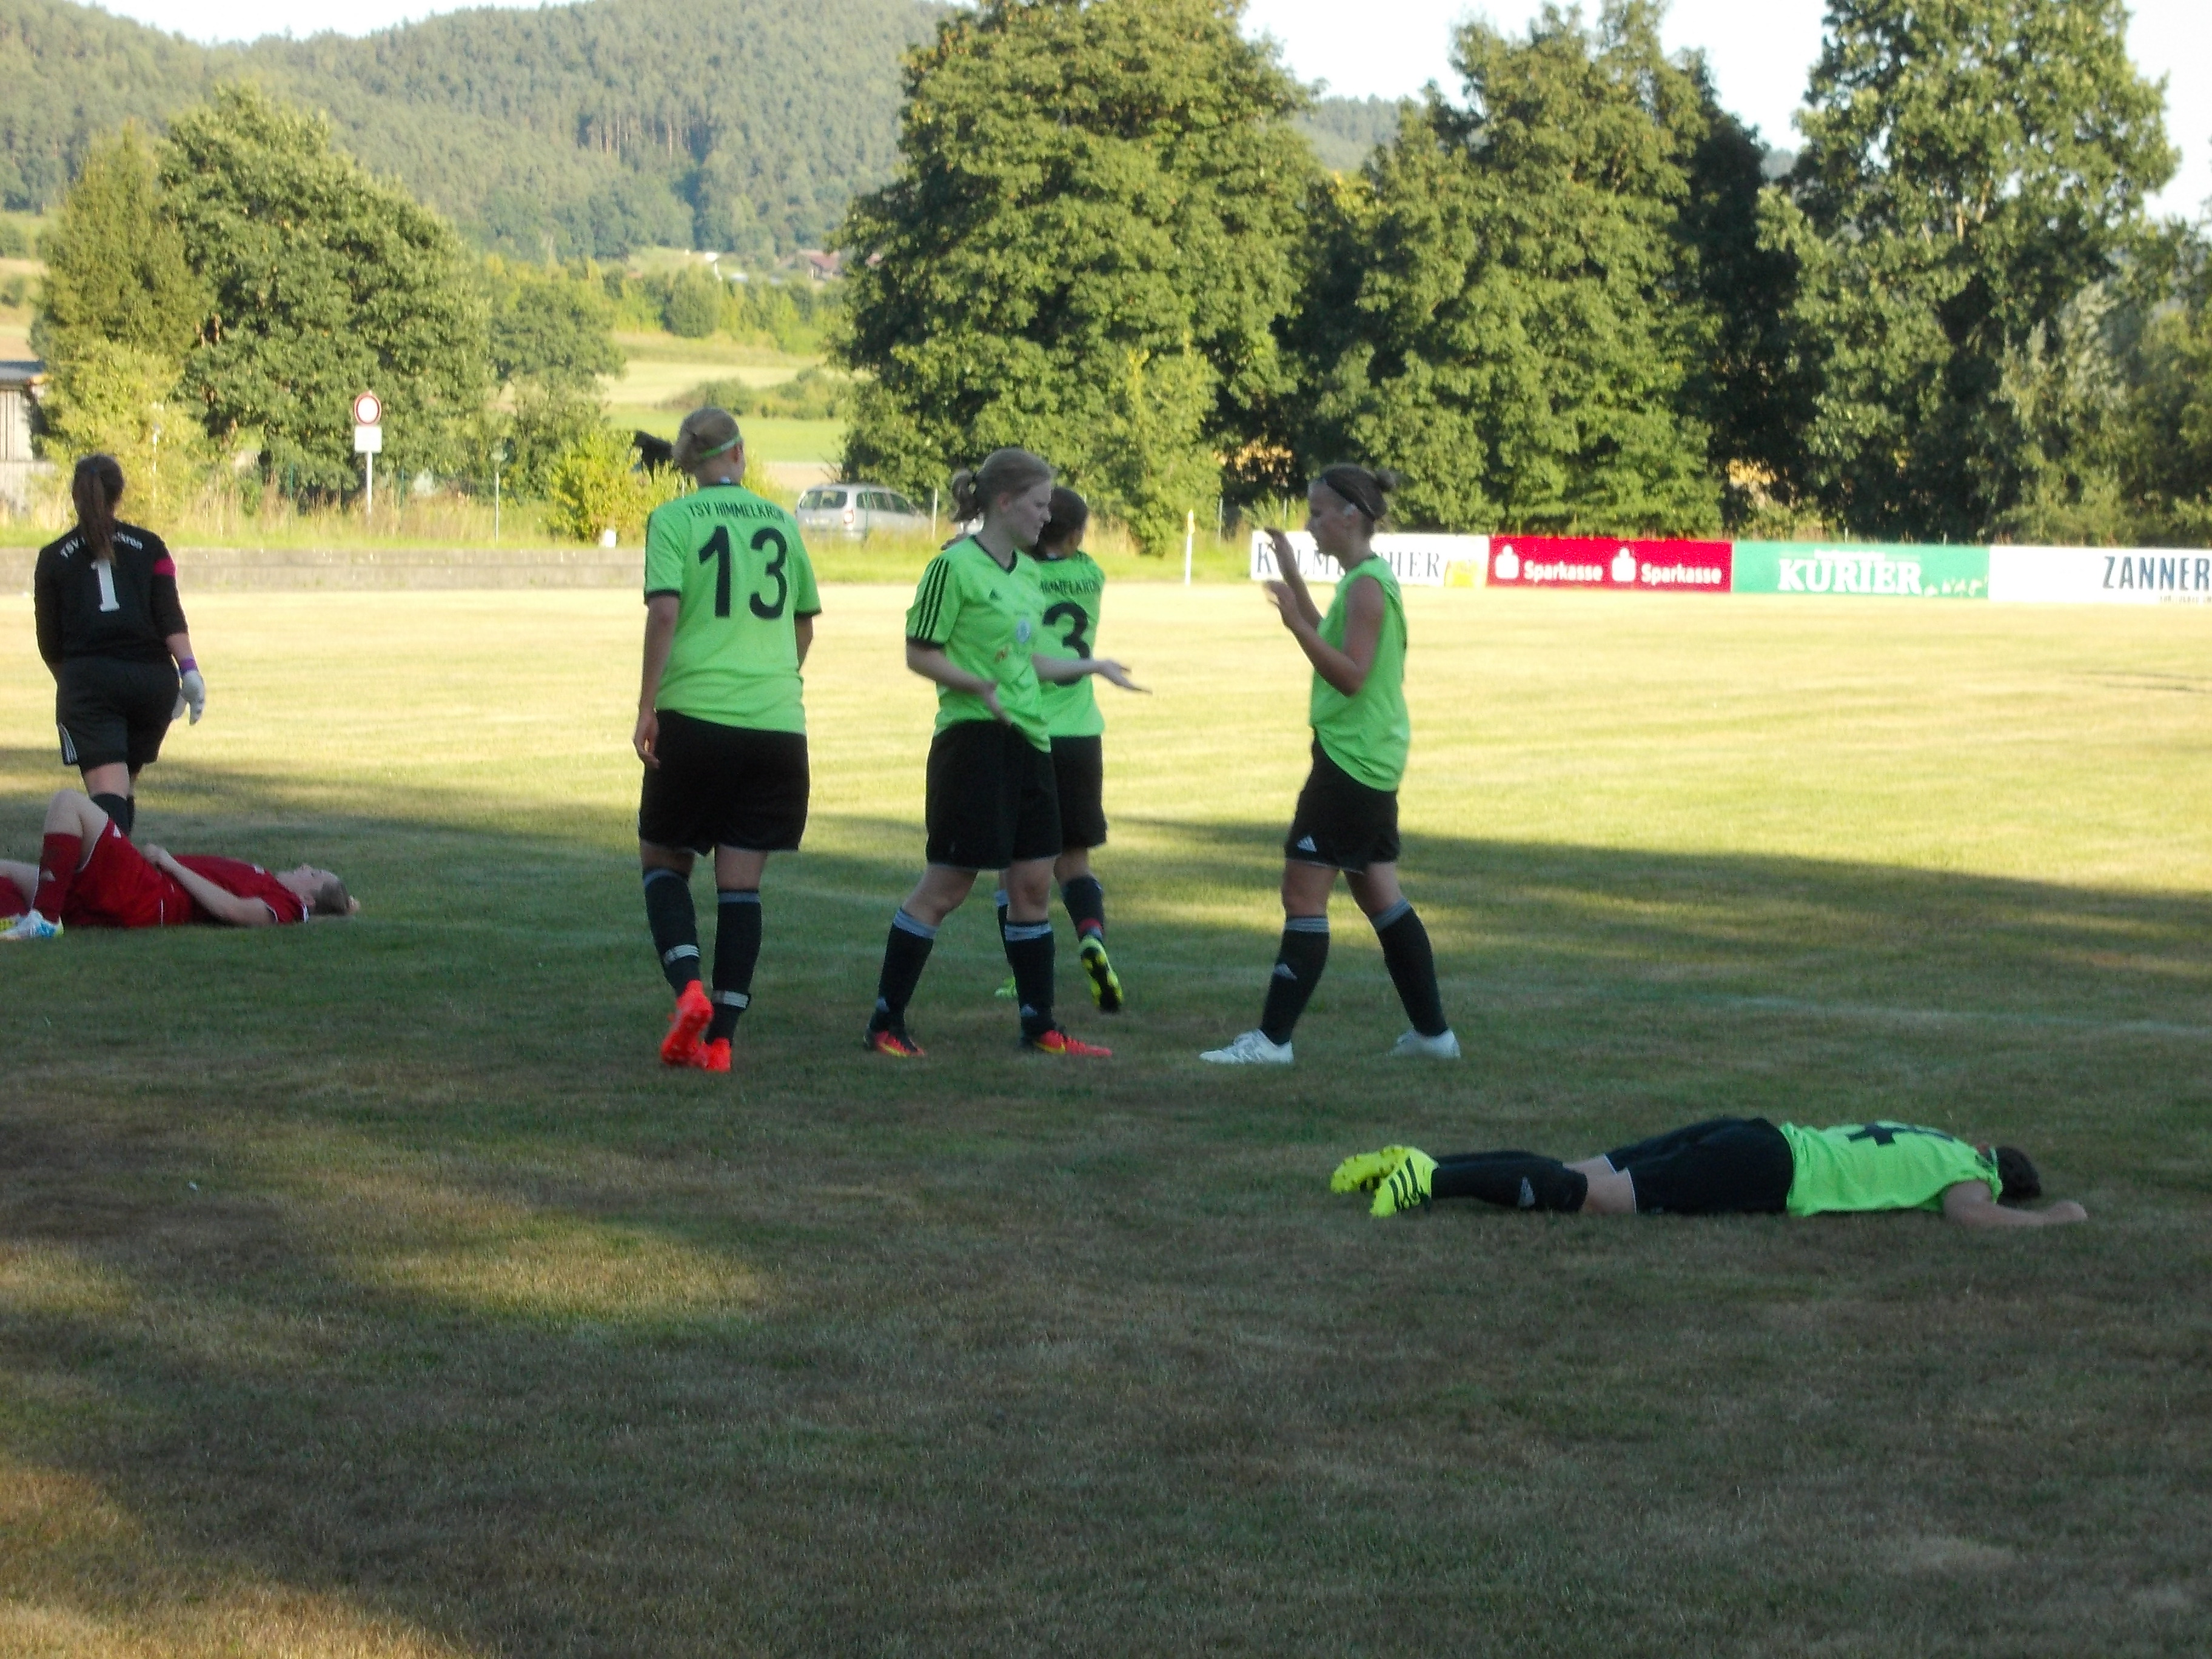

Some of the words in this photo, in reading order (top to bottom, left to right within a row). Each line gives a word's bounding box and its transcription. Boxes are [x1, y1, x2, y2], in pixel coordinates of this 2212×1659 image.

[698, 525, 788, 620] 13
[1256, 542, 1441, 578] KLMHER
[1524, 560, 1604, 583] Sparkasse
[1641, 563, 1723, 586] Sparkasse
[1777, 558, 1922, 595] KURIER
[2102, 555, 2211, 592] ZANNER
[91, 559, 120, 612] 1
[1042, 601, 1091, 687] 3
